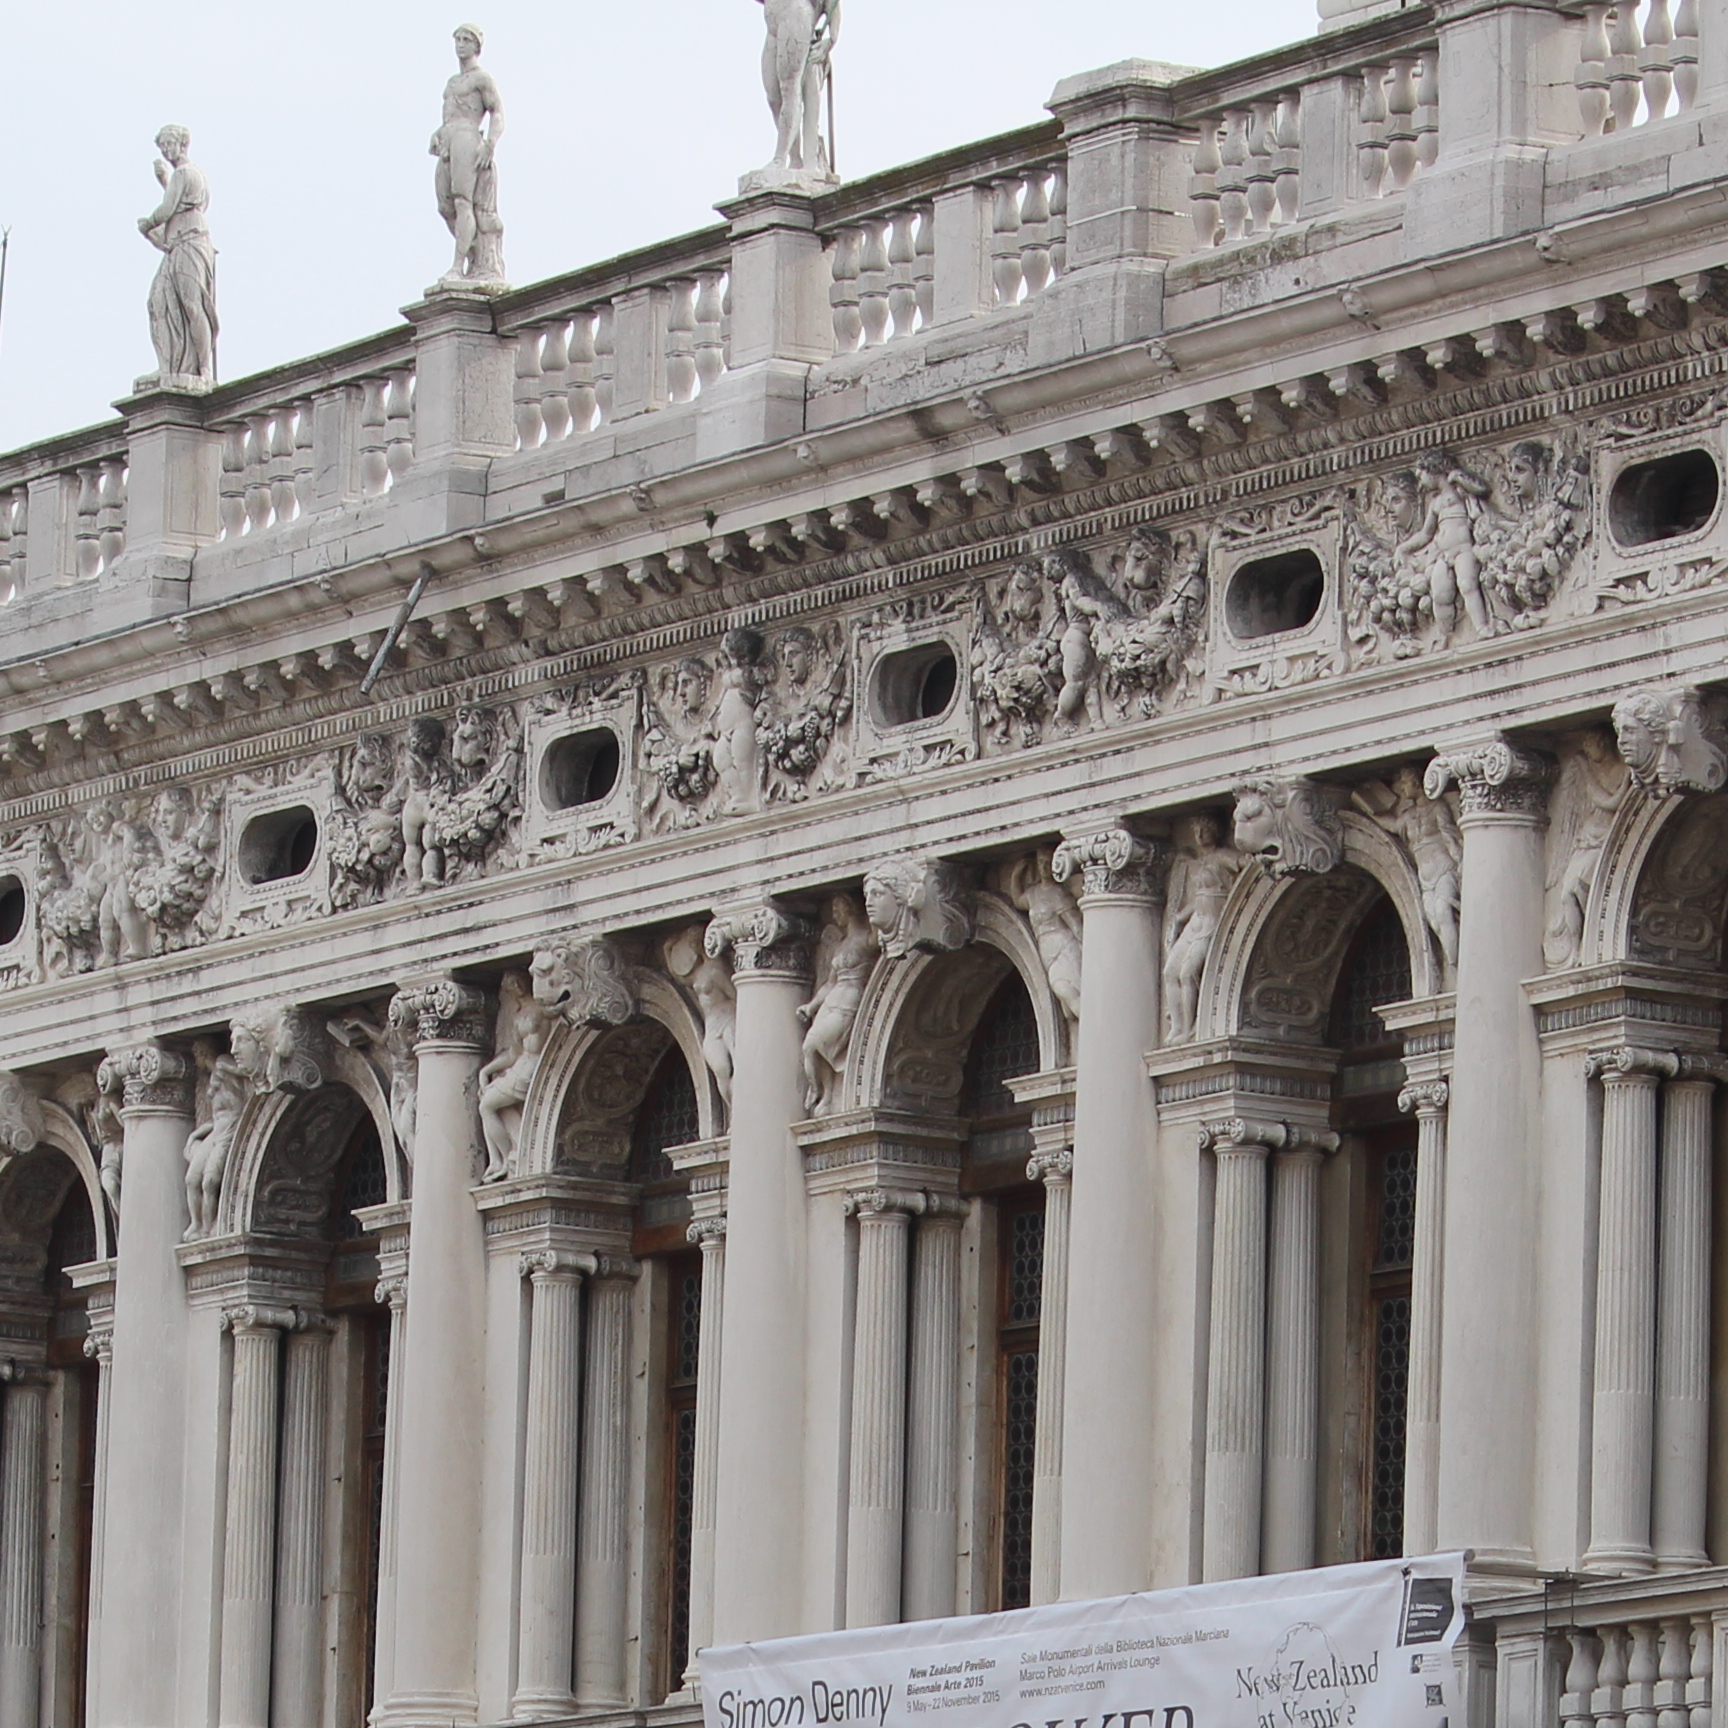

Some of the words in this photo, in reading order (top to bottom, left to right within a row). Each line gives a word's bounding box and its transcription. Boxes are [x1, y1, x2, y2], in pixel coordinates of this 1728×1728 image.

[1039, 1644, 1093, 1662] Monumentali
[1116, 1638, 1155, 1653] Biblioteca
[1156, 1632, 1193, 1648] Nazionale
[1195, 1628, 1229, 1642] Marciana
[909, 1667, 928, 1680] New
[929, 1661, 963, 1677] Zealand
[964, 1658, 996, 1672] Pavilion
[1020, 1668, 1046, 1682] Marco
[1047, 1665, 1066, 1679] Polo
[1068, 1660, 1095, 1678] Airport
[1096, 1656, 1128, 1673] Arrivals
[1129, 1654, 1161, 1671] Lounge
[1235, 1667, 1282, 1699] New
[1290, 1650, 1379, 1692] Zealand
[907, 1681, 942, 1696] Biennale
[943, 1679, 962, 1692] Arte
[963, 1675, 985, 1689] 2015
[1020, 1678, 1105, 1699] www.nzatvenice.com
[811, 1680, 893, 1727] Denny
[906, 1700, 912, 1713] 9
[941, 1694, 981, 1708] November
[982, 1689, 1001, 1704] 2015
